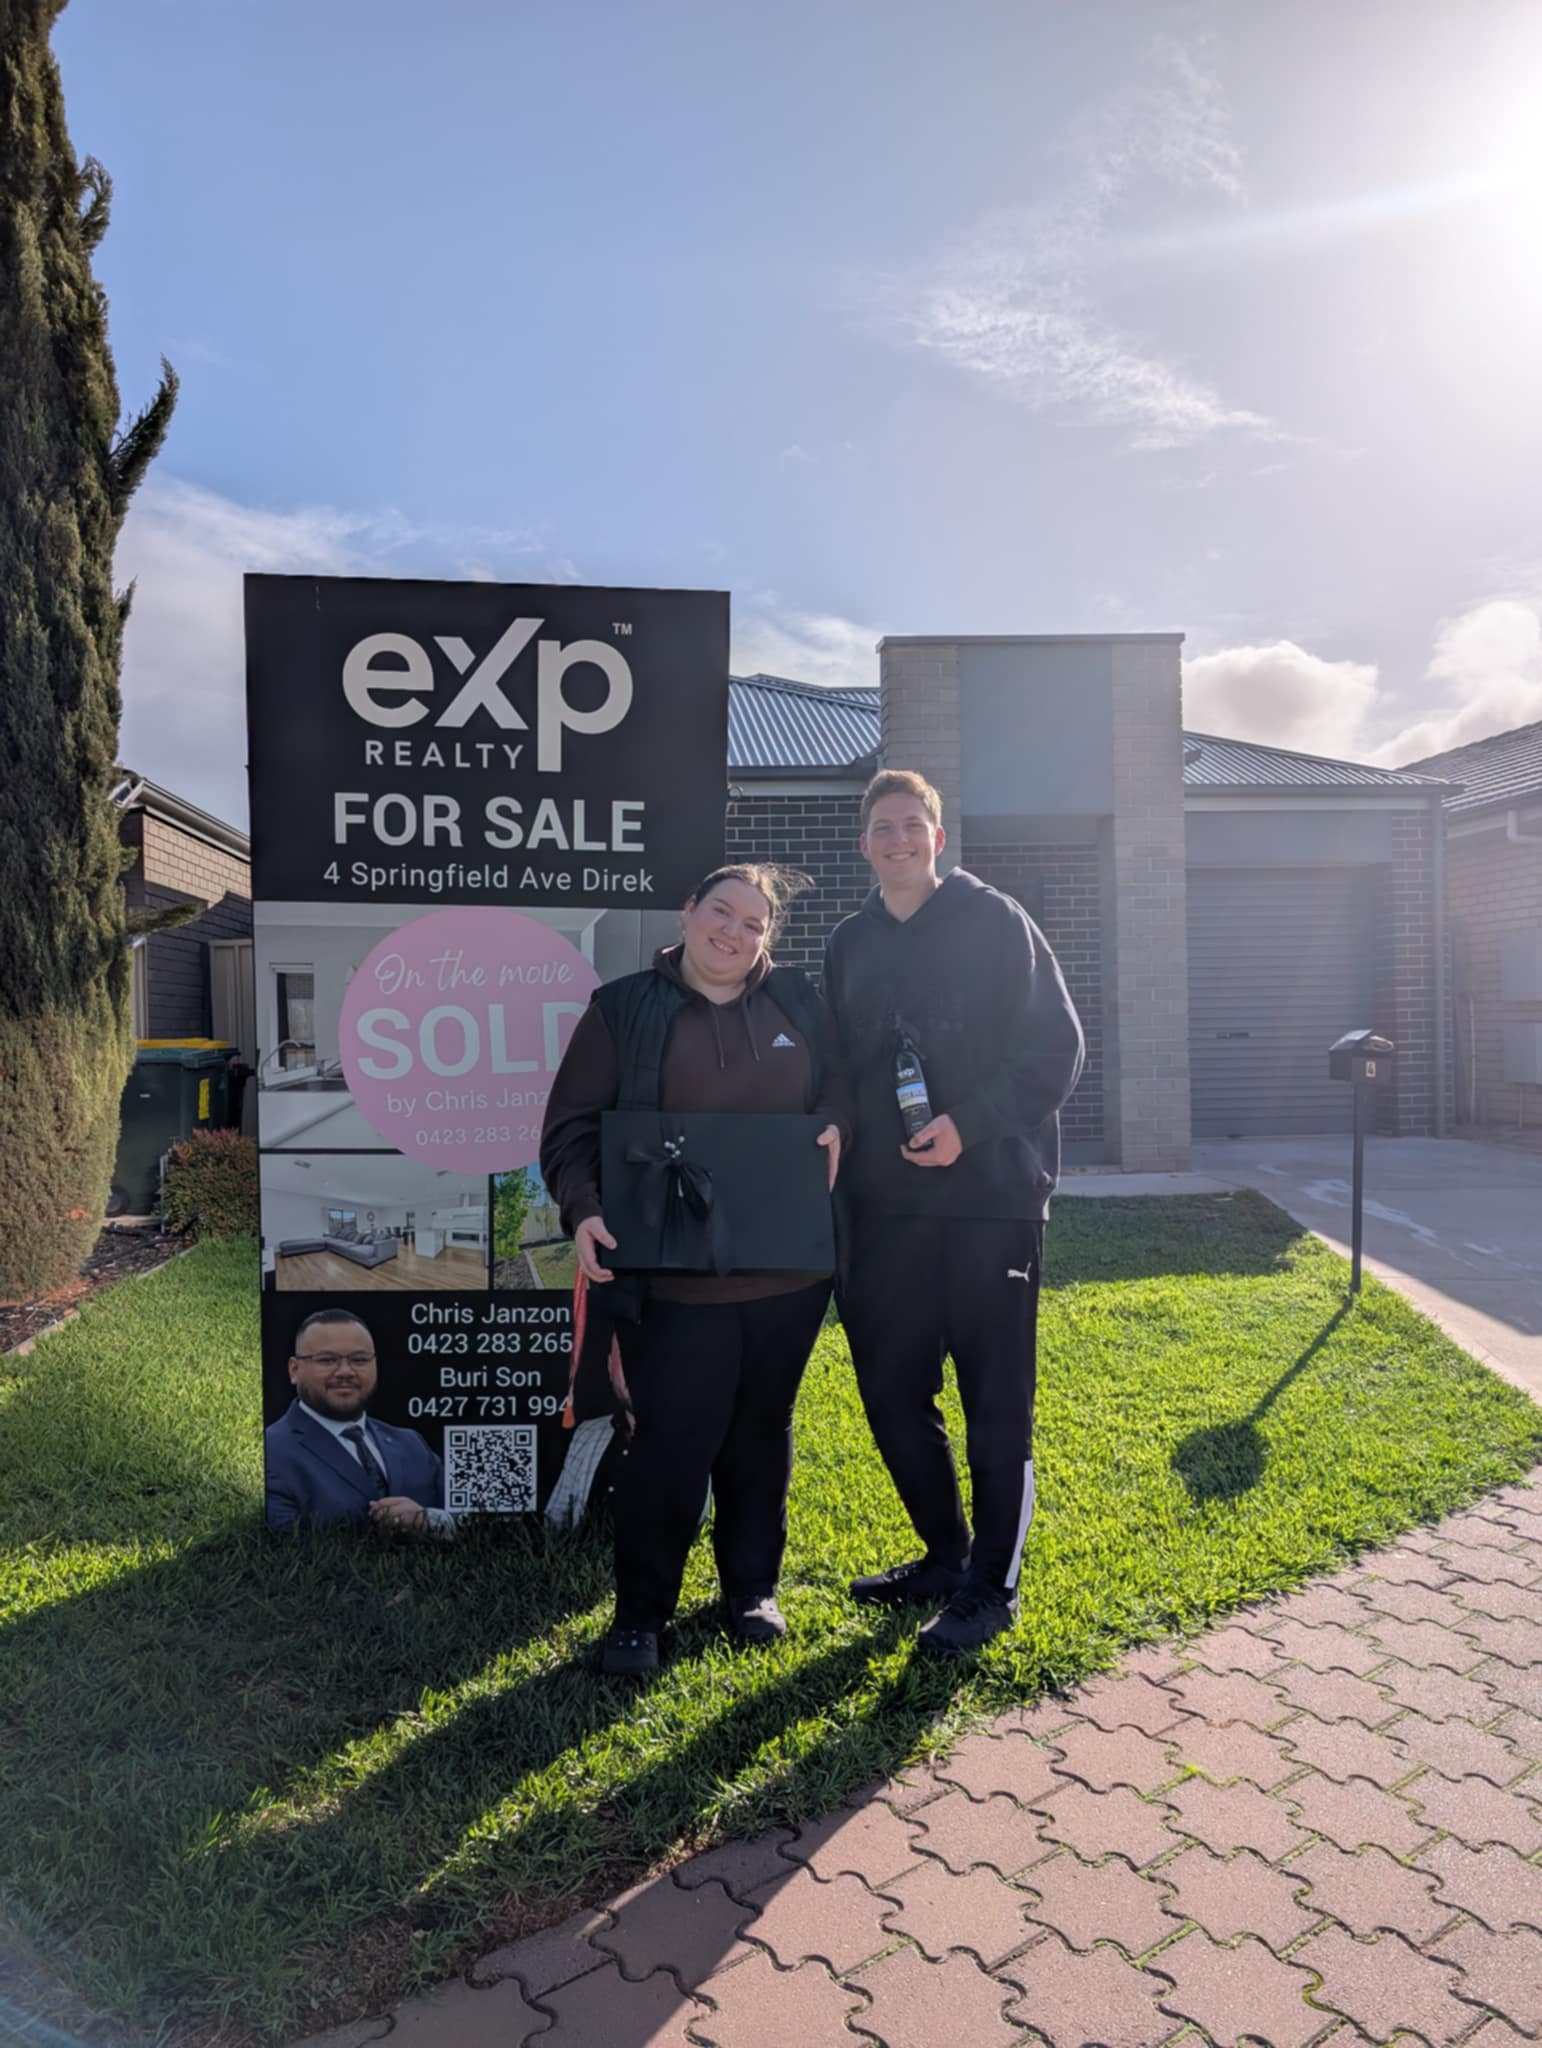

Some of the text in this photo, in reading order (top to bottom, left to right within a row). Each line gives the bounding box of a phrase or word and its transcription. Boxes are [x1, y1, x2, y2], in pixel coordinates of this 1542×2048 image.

[365, 740, 524, 769] REALTY
[334, 792, 646, 852] FOR SALE
[323, 862, 654, 893] 4 Springfield Ave Direk
[374, 949, 574, 995] On the move
[387, 1091, 416, 1119] by
[425, 1088, 488, 1112] Chris
[415, 1124, 541, 1147] 0423 283 26
[411, 1302, 570, 1325] Chris Janzon
[408, 1332, 573, 1355] 0423 283 265
[440, 1366, 542, 1388] Buri Son
[408, 1397, 468, 1418] 0427
[476, 1396, 517, 1417] 731
